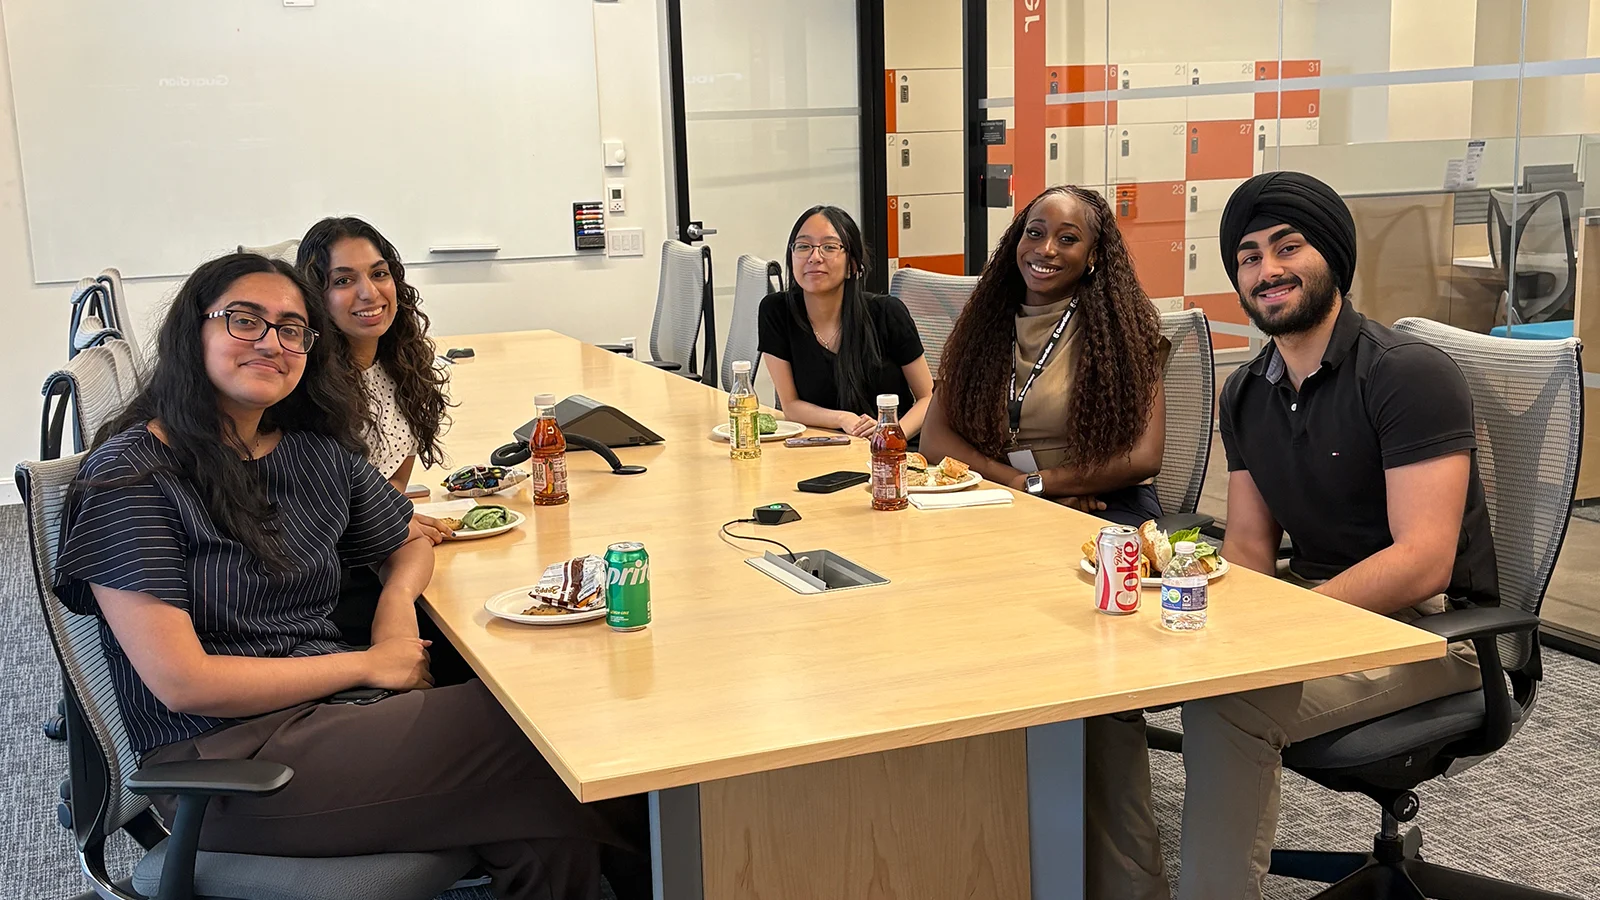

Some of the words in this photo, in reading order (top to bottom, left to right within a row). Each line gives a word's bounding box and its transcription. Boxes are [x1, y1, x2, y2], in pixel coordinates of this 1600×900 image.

[1174, 64, 1186, 76] 21
[1241, 63, 1253, 74] 26
[1308, 62, 1319, 72] 31
[888, 72, 894, 84] 1
[1308, 103, 1316, 114] D
[1172, 125, 1185, 136] 22
[1240, 123, 1252, 135] 27
[1306, 121, 1318, 131] 32
[888, 135, 895, 147] 2
[1172, 184, 1185, 195] 23
[889, 198, 897, 210] 3
[1171, 241, 1183, 252] 24
[890, 260, 897, 270] 4
[1170, 300, 1183, 309] 25
[1113, 546, 1123, 566] Diet
[604, 559, 650, 590] prit
[1115, 541, 1139, 611] Coke
